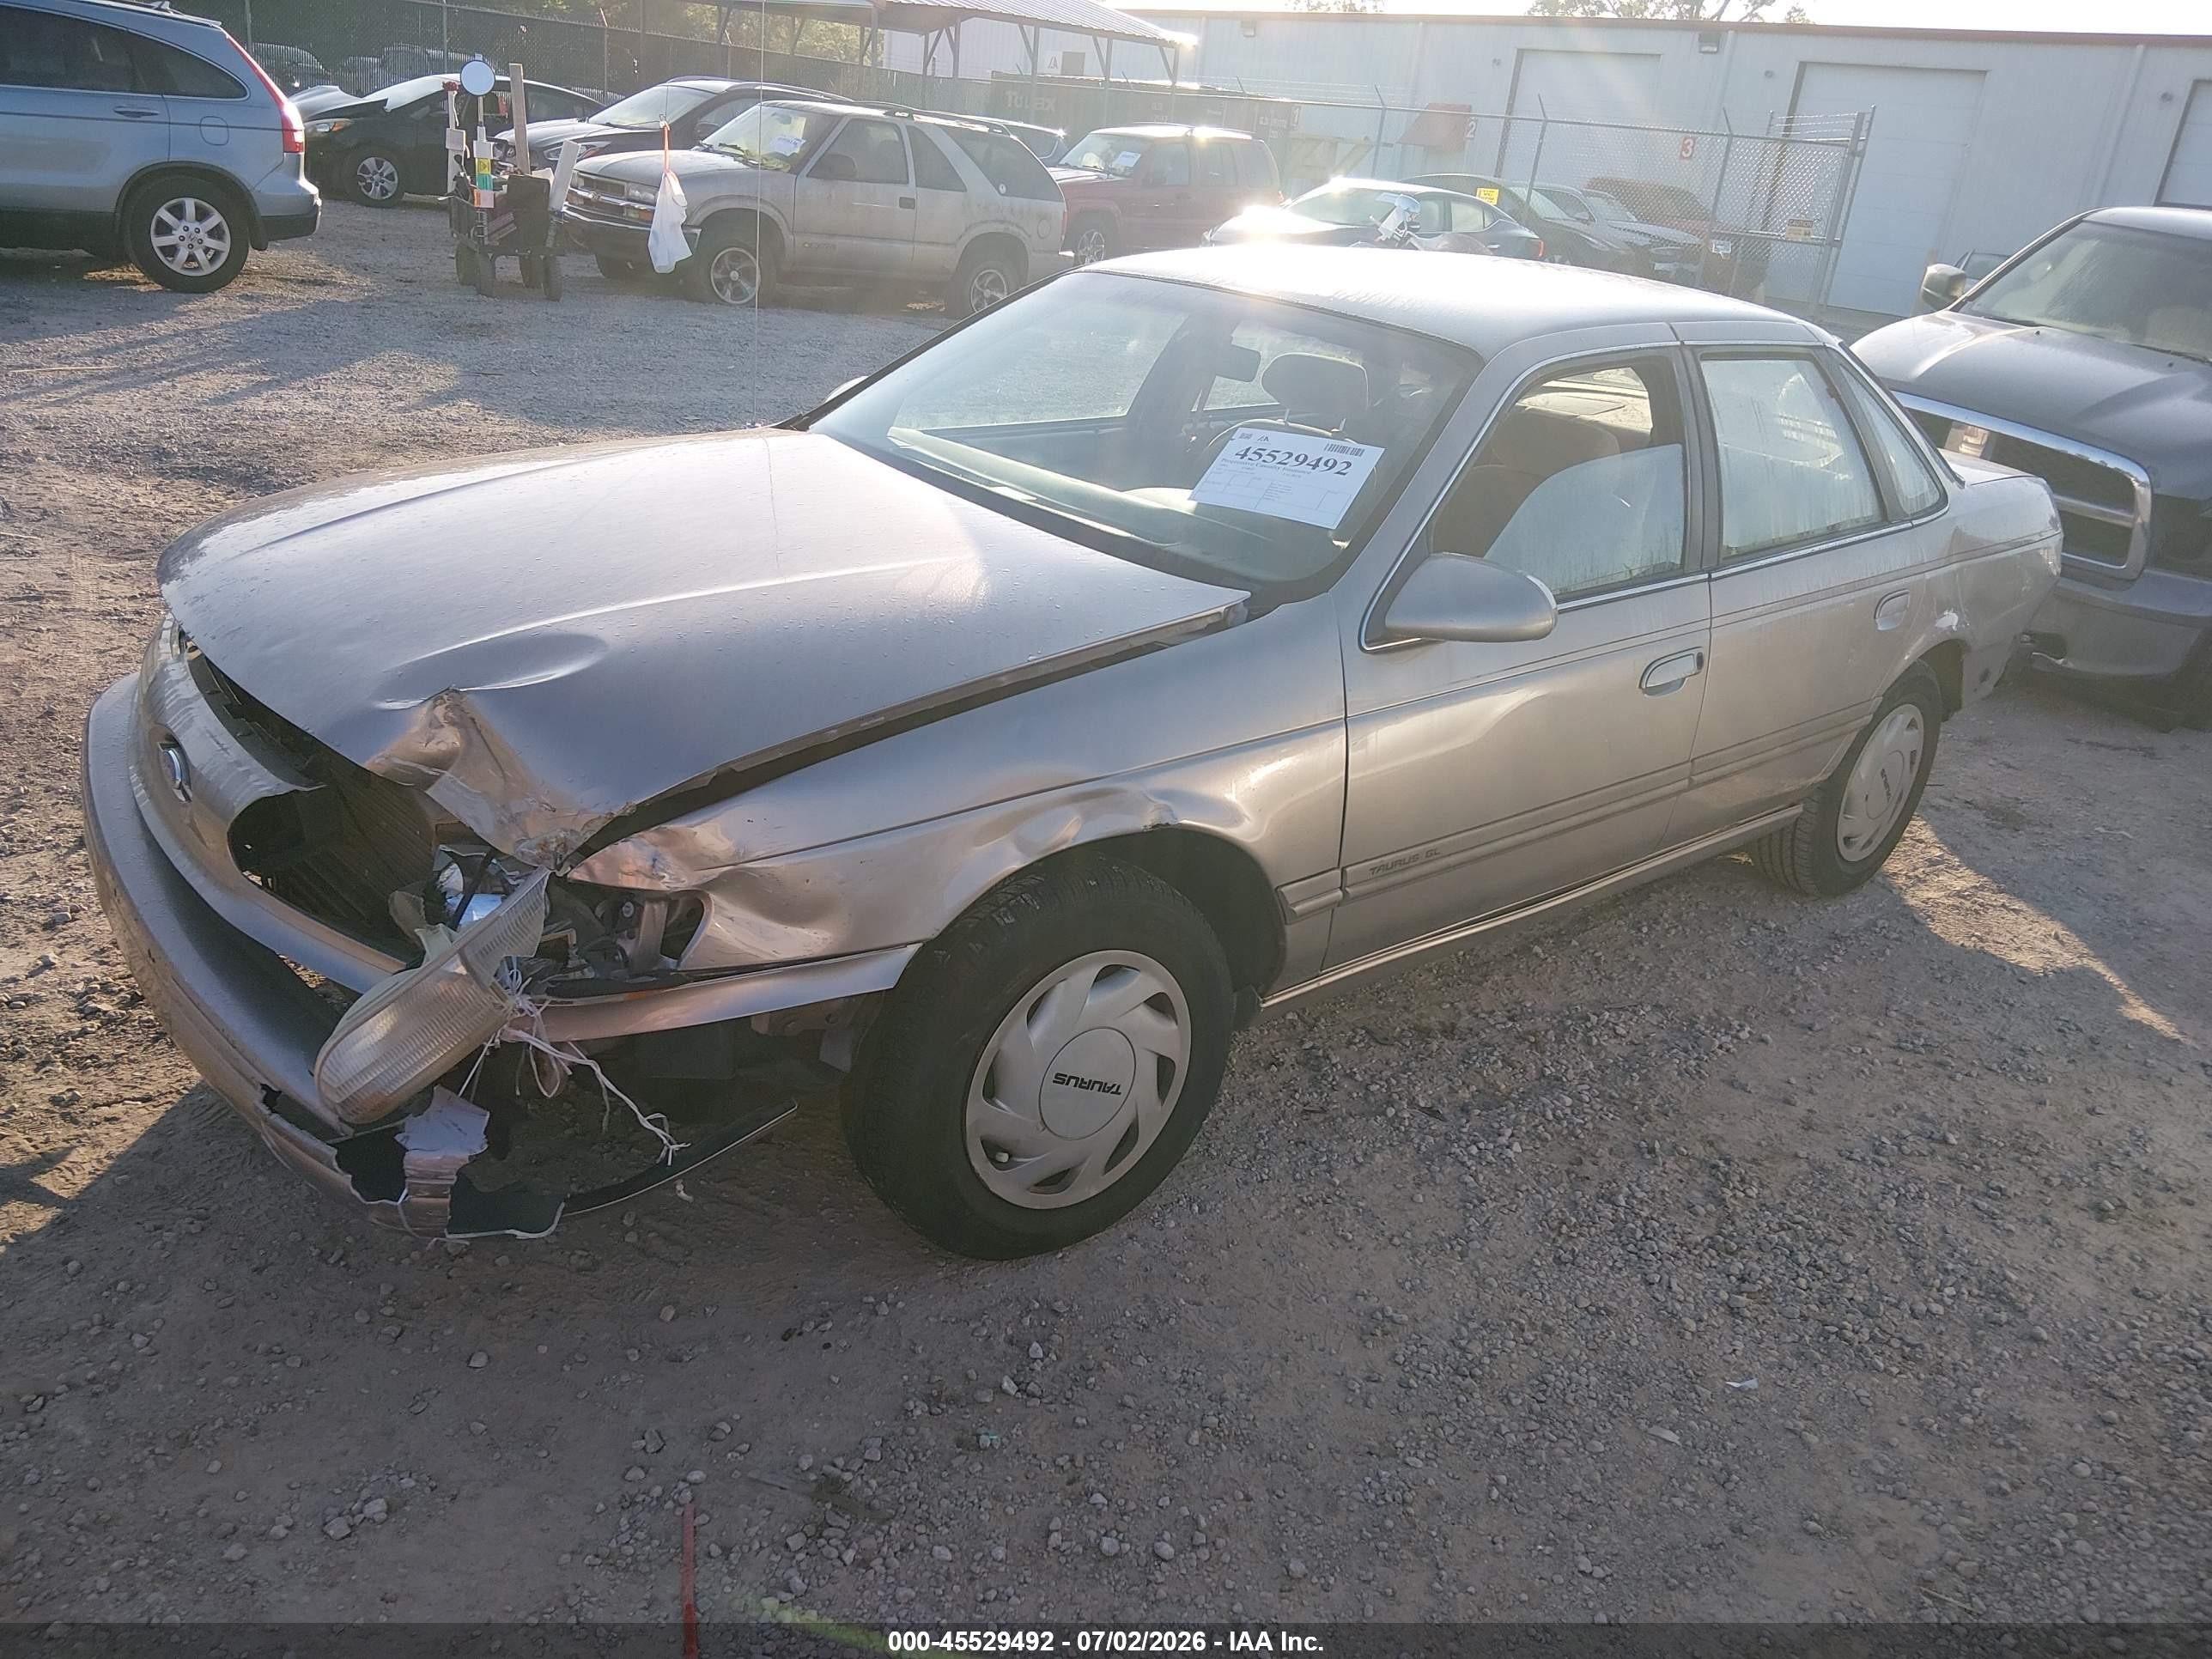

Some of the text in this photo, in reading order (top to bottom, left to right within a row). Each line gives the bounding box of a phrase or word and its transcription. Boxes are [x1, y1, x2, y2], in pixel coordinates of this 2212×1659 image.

[1464, 120, 1476, 138] 2
[1681, 137, 1693, 158] 3
[1235, 446, 1352, 476] 45529492
[1368, 848, 1441, 875] TAURUS GL
[1053, 1073, 1121, 1096] TAURUS
